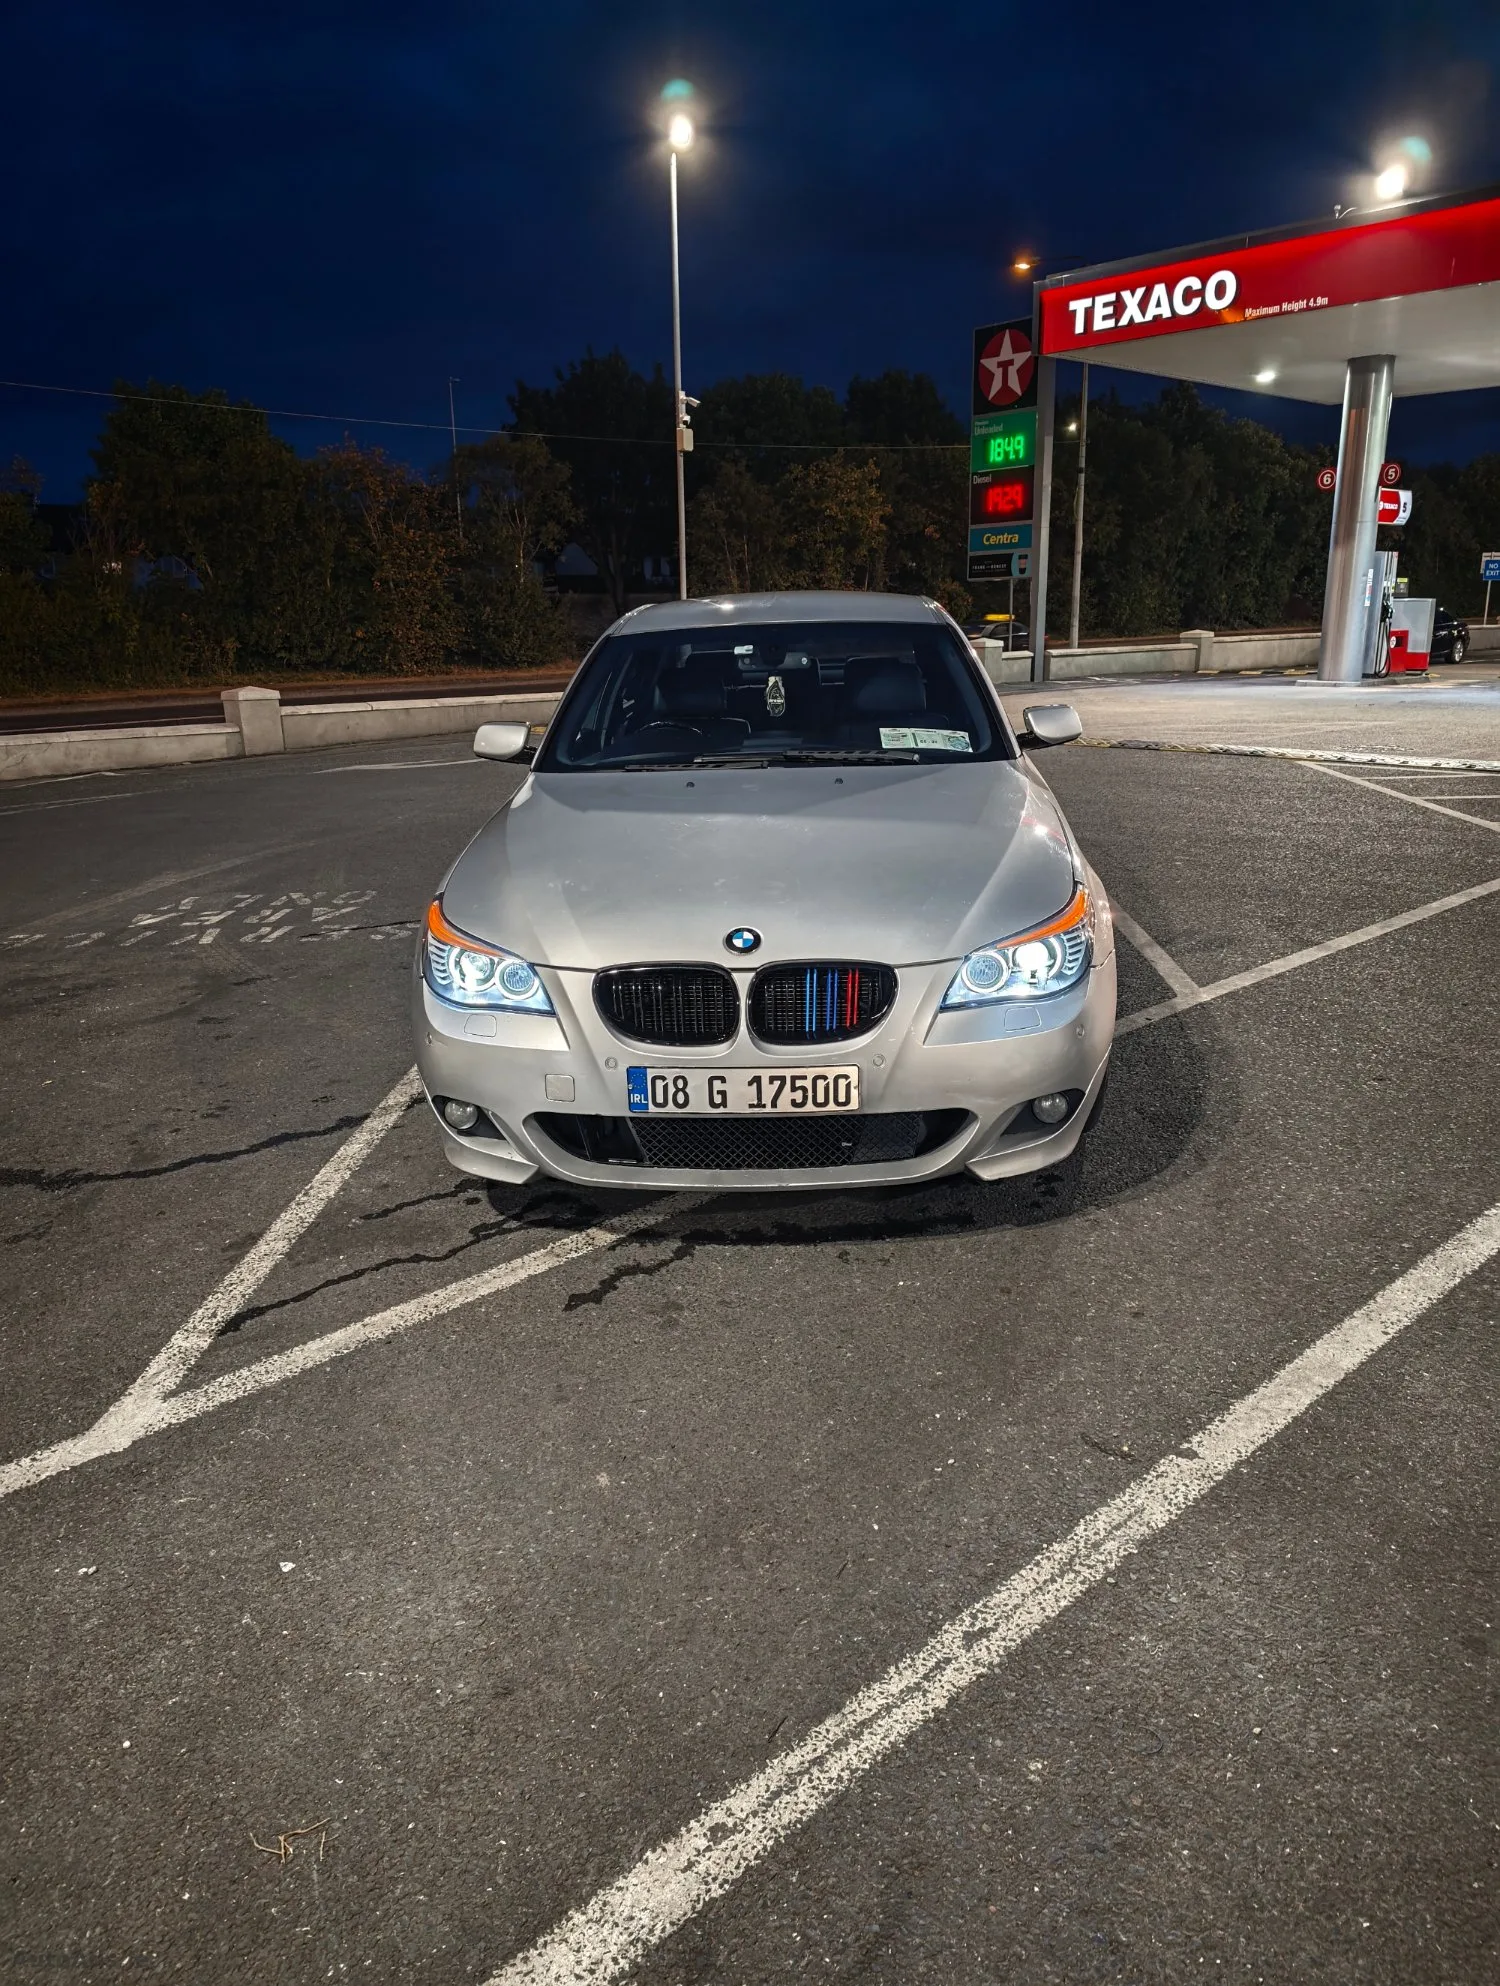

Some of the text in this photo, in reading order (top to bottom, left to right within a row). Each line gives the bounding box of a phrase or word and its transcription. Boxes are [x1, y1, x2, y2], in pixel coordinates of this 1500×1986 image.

[1069, 270, 1237, 335] TEXACO
[1245, 296, 1329, 318] Maximum Height 4.9m
[973, 474, 992, 485] Diesel
[1323, 474, 1332, 485] 6
[1387, 468, 1396, 480] 5
[1402, 502, 1408, 513] 5
[983, 533, 1019, 545] Centra
[127, 907, 359, 927] AREA
[630, 1074, 852, 1109] IRL 08 G 17500
